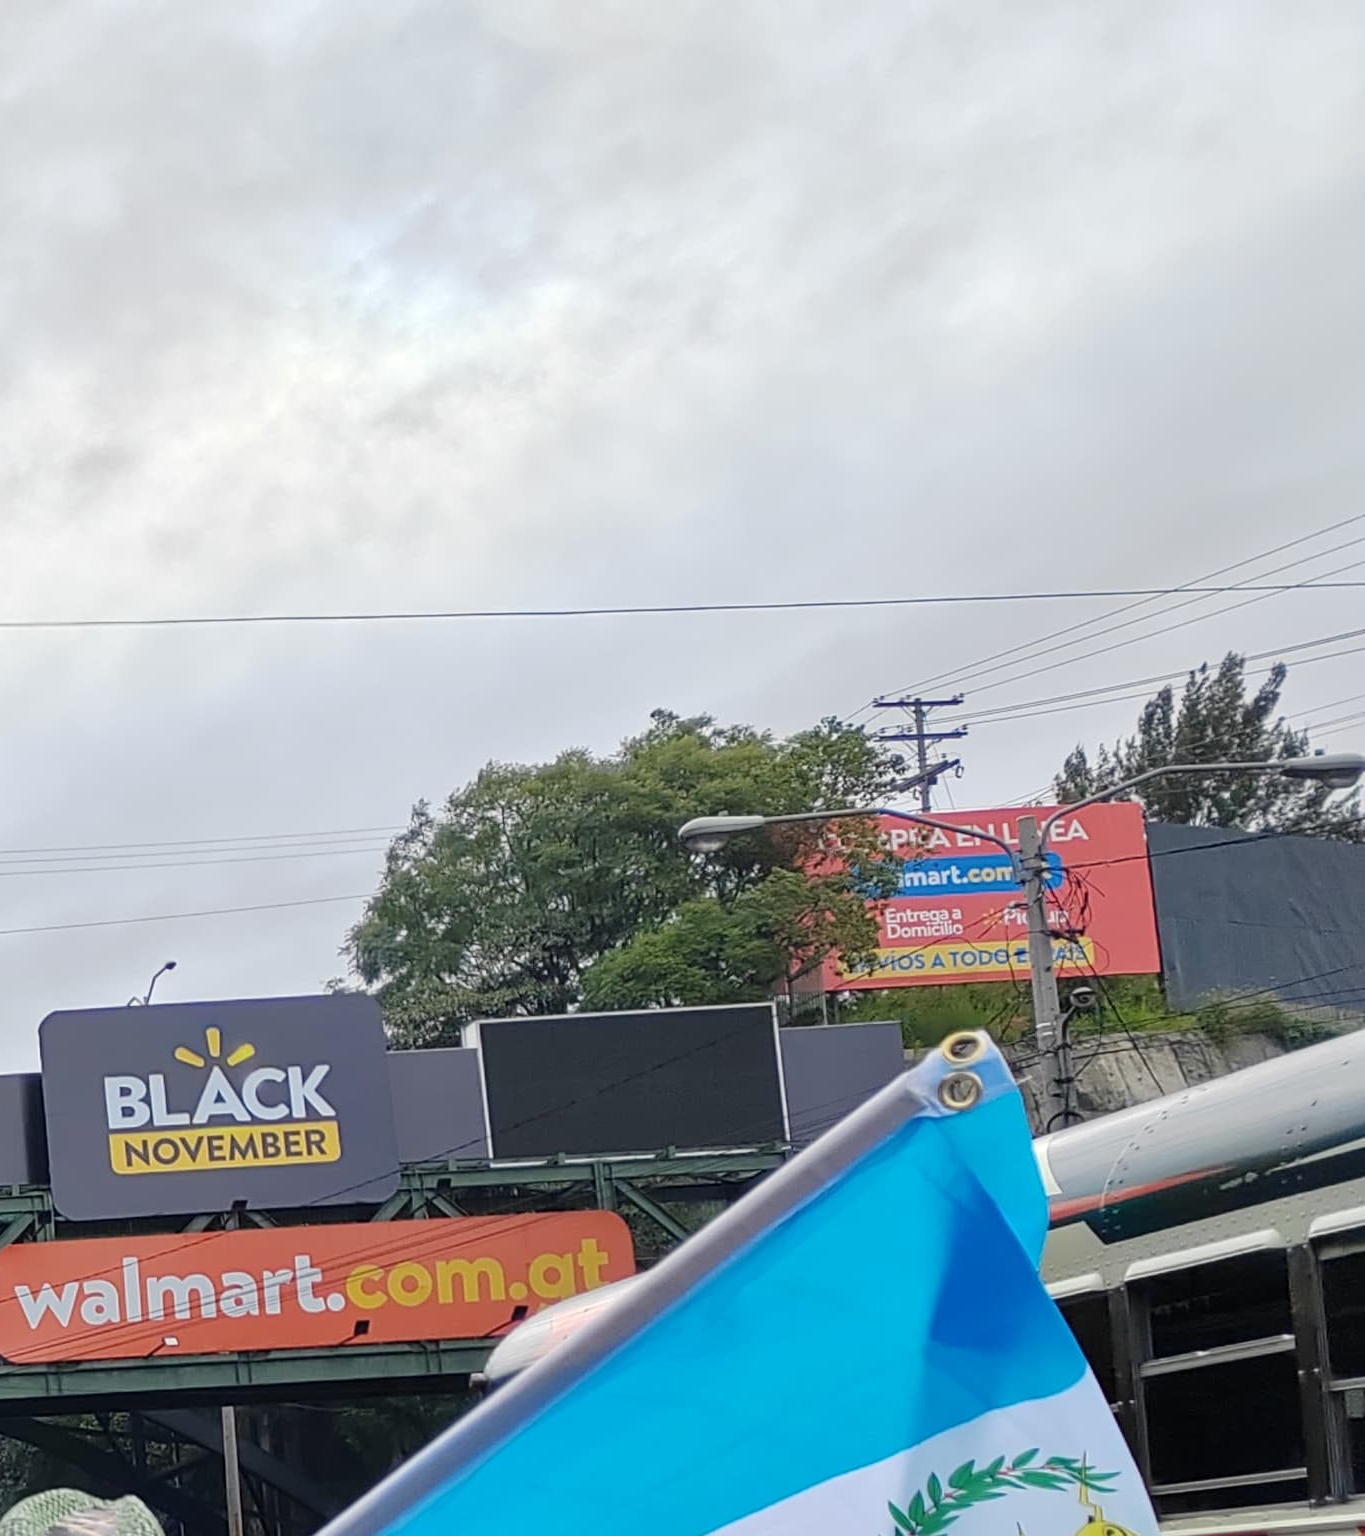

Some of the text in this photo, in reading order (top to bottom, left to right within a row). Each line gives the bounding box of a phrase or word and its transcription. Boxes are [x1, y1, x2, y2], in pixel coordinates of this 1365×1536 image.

[885, 908, 962, 926] Entrega a
[1004, 909, 1070, 928] Picup
[886, 922, 964, 939] Domicilio
[931, 953, 946, 968] A
[949, 948, 1010, 967] TODO
[104, 1064, 336, 1129] BLACK
[124, 1129, 327, 1167] NOVEMBER
[13, 1238, 609, 1330] walmart.com.gt
